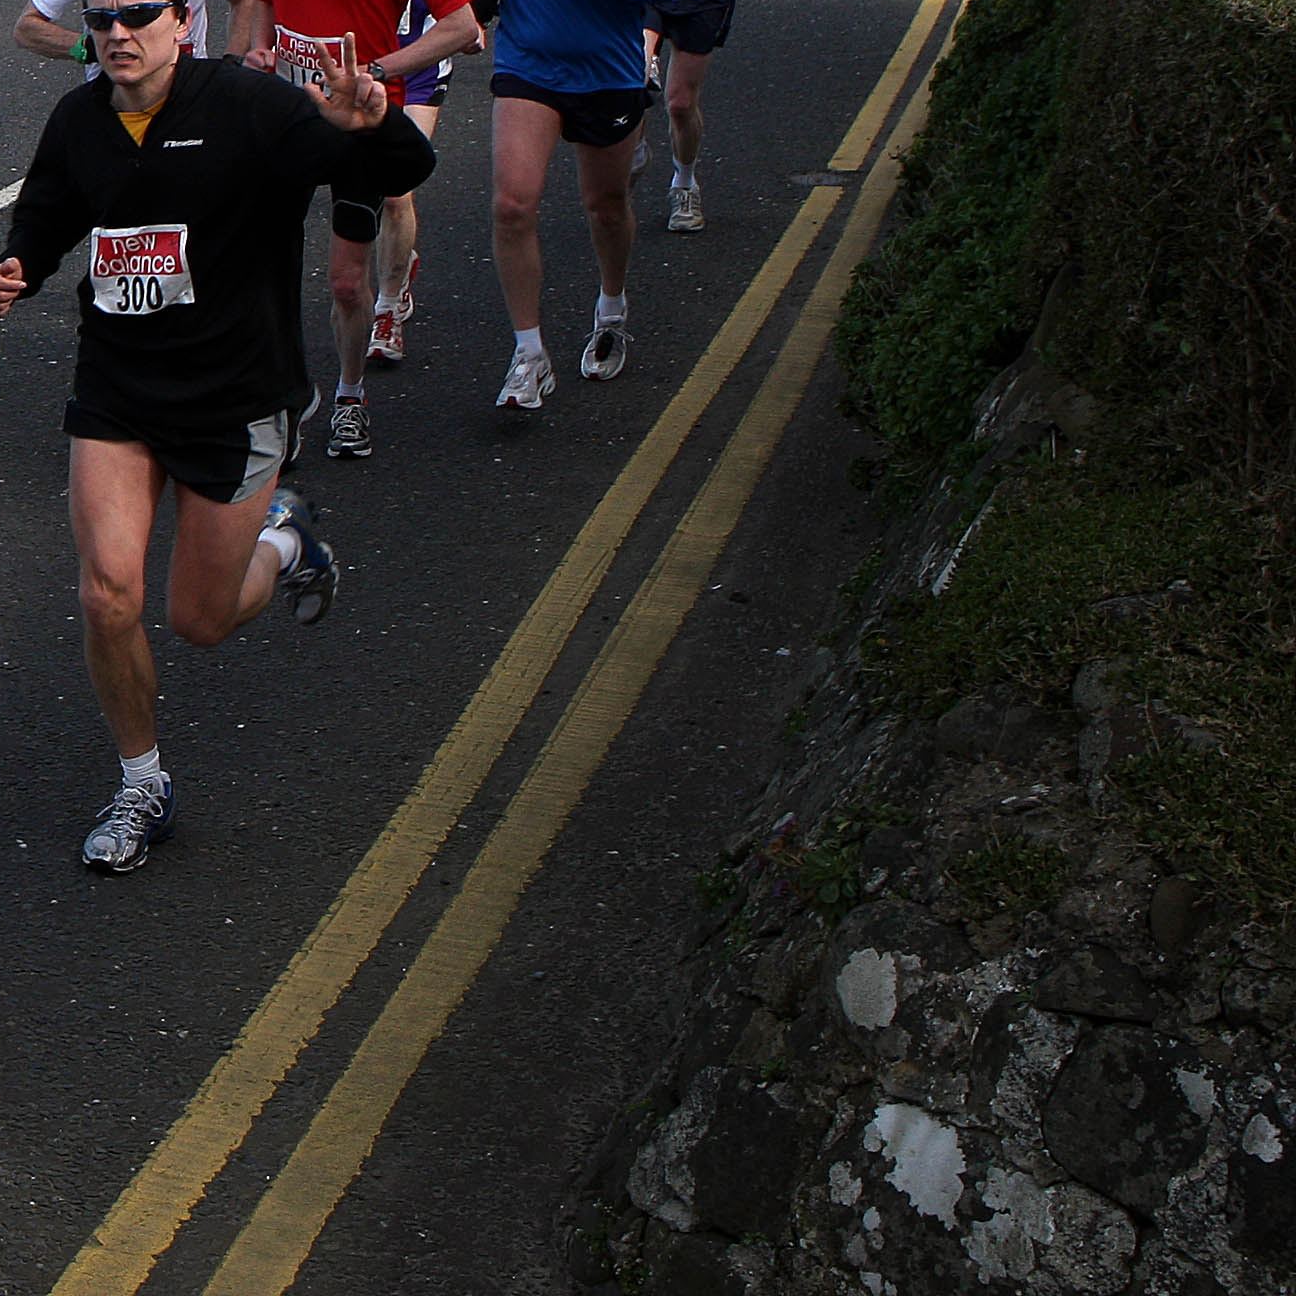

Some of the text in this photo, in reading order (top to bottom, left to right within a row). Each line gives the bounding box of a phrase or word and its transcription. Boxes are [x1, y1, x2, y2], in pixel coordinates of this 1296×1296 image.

[289, 38, 316, 56] new
[111, 234, 157, 255] new
[95, 254, 176, 277] balance
[116, 276, 164, 312] 300
